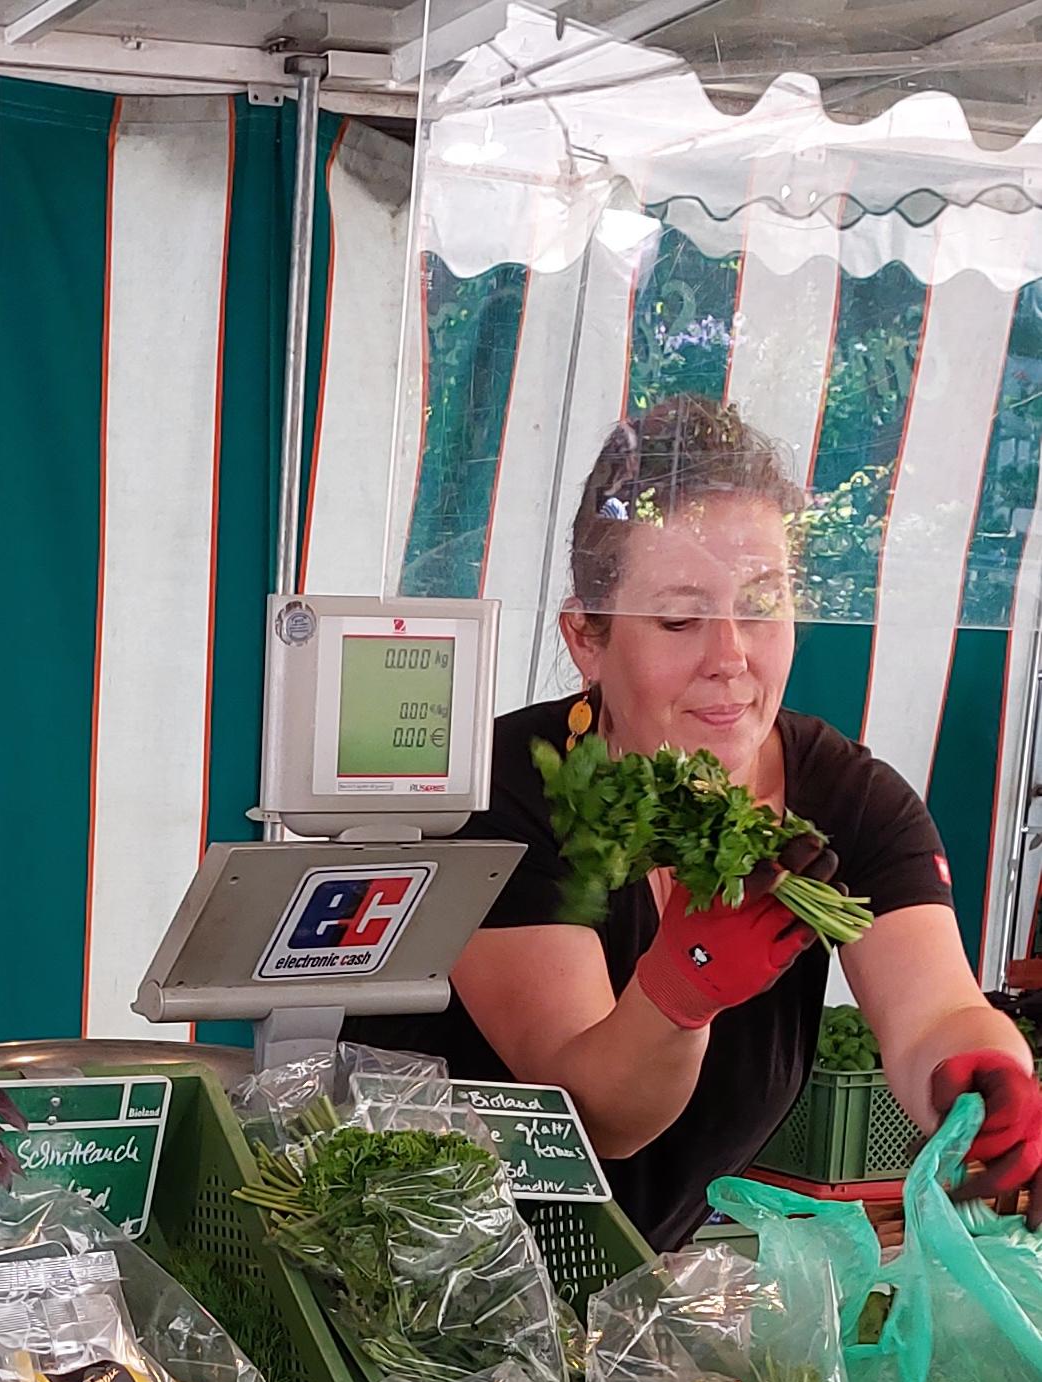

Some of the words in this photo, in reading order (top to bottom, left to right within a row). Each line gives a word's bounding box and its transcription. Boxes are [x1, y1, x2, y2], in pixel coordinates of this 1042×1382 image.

[434, 650, 449, 668] kg
[429, 728, 446, 748] €
[275, 952, 339, 969] electronic
[340, 951, 372, 966] cash
[468, 1090, 544, 1110] Bioland
[128, 1106, 160, 1118] Bioland
